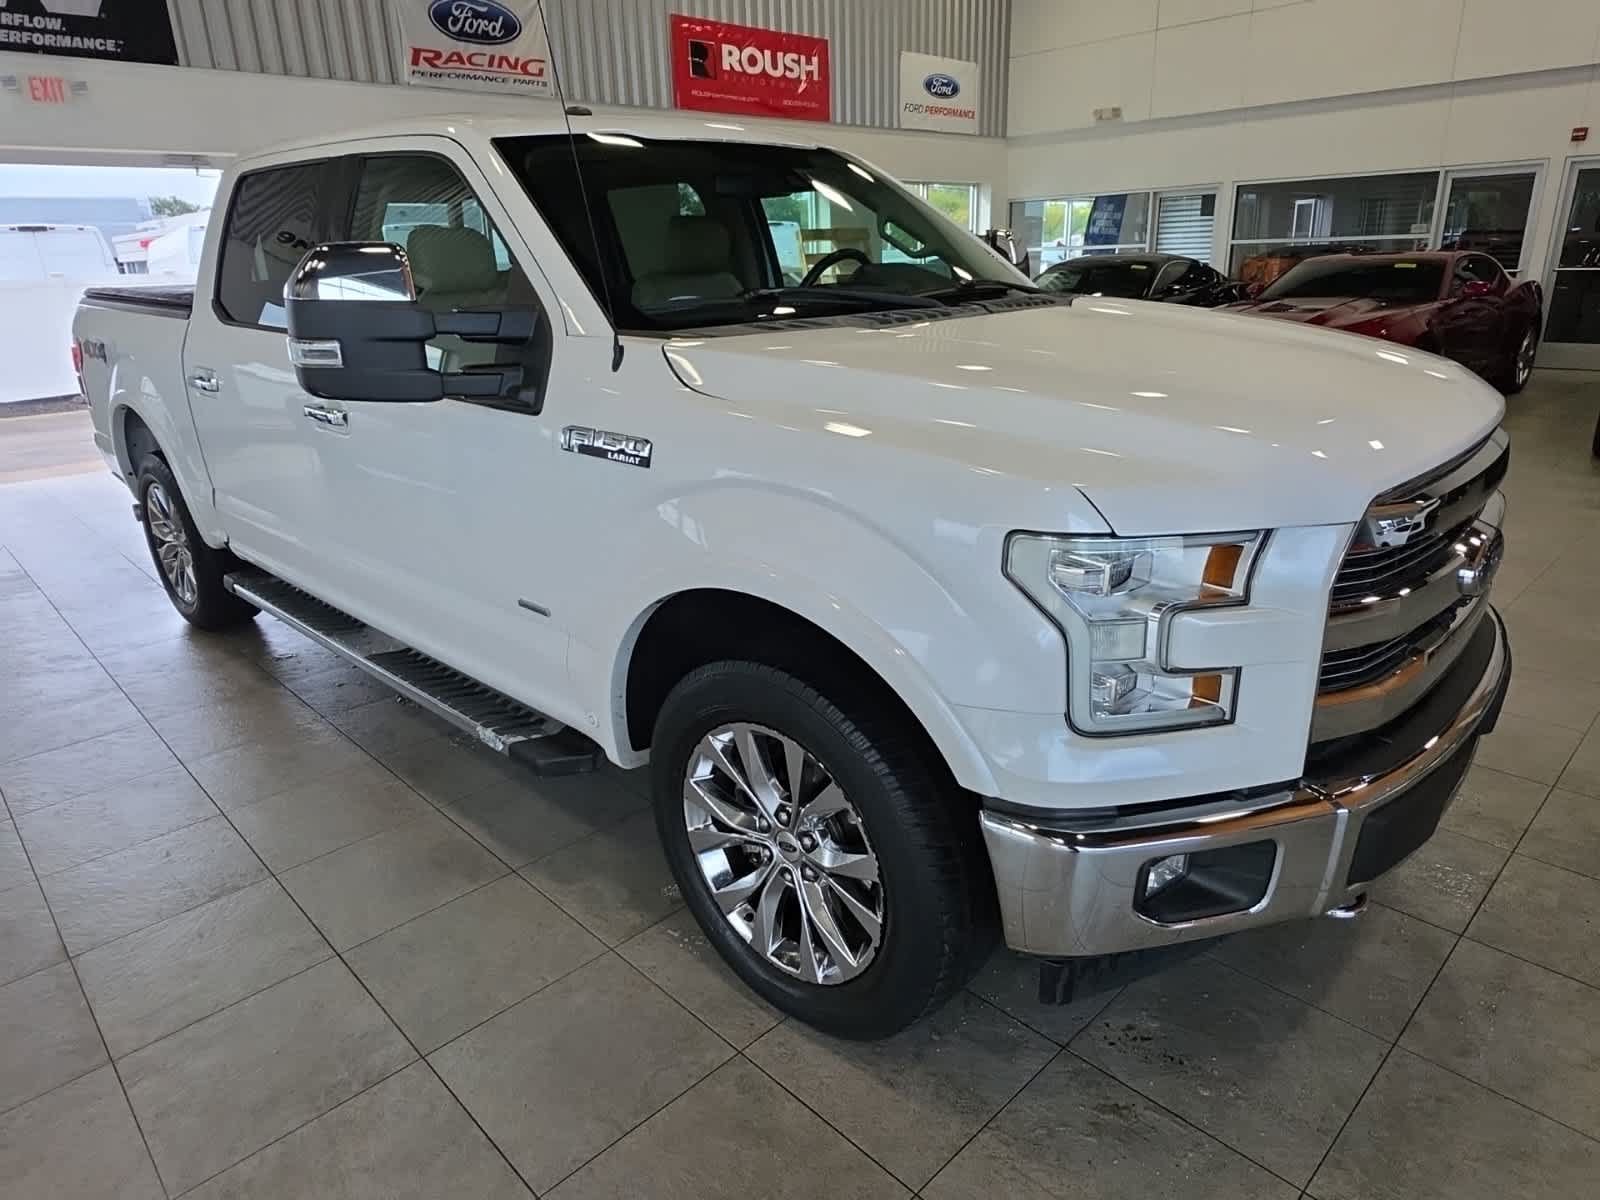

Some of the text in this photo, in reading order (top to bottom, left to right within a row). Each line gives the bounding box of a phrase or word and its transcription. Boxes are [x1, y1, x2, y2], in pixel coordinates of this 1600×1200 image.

[448, 1, 505, 38] Ford
[410, 47, 546, 77] RACING
[721, 43, 819, 81] ROUSH
[28, 75, 65, 104] EXIT
[411, 69, 548, 88] PERFORMANCE PARTS
[930, 77, 954, 96] Ford
[903, 103, 977, 119] FORD PERFORMANCE
[607, 451, 641, 465] LARIAT
